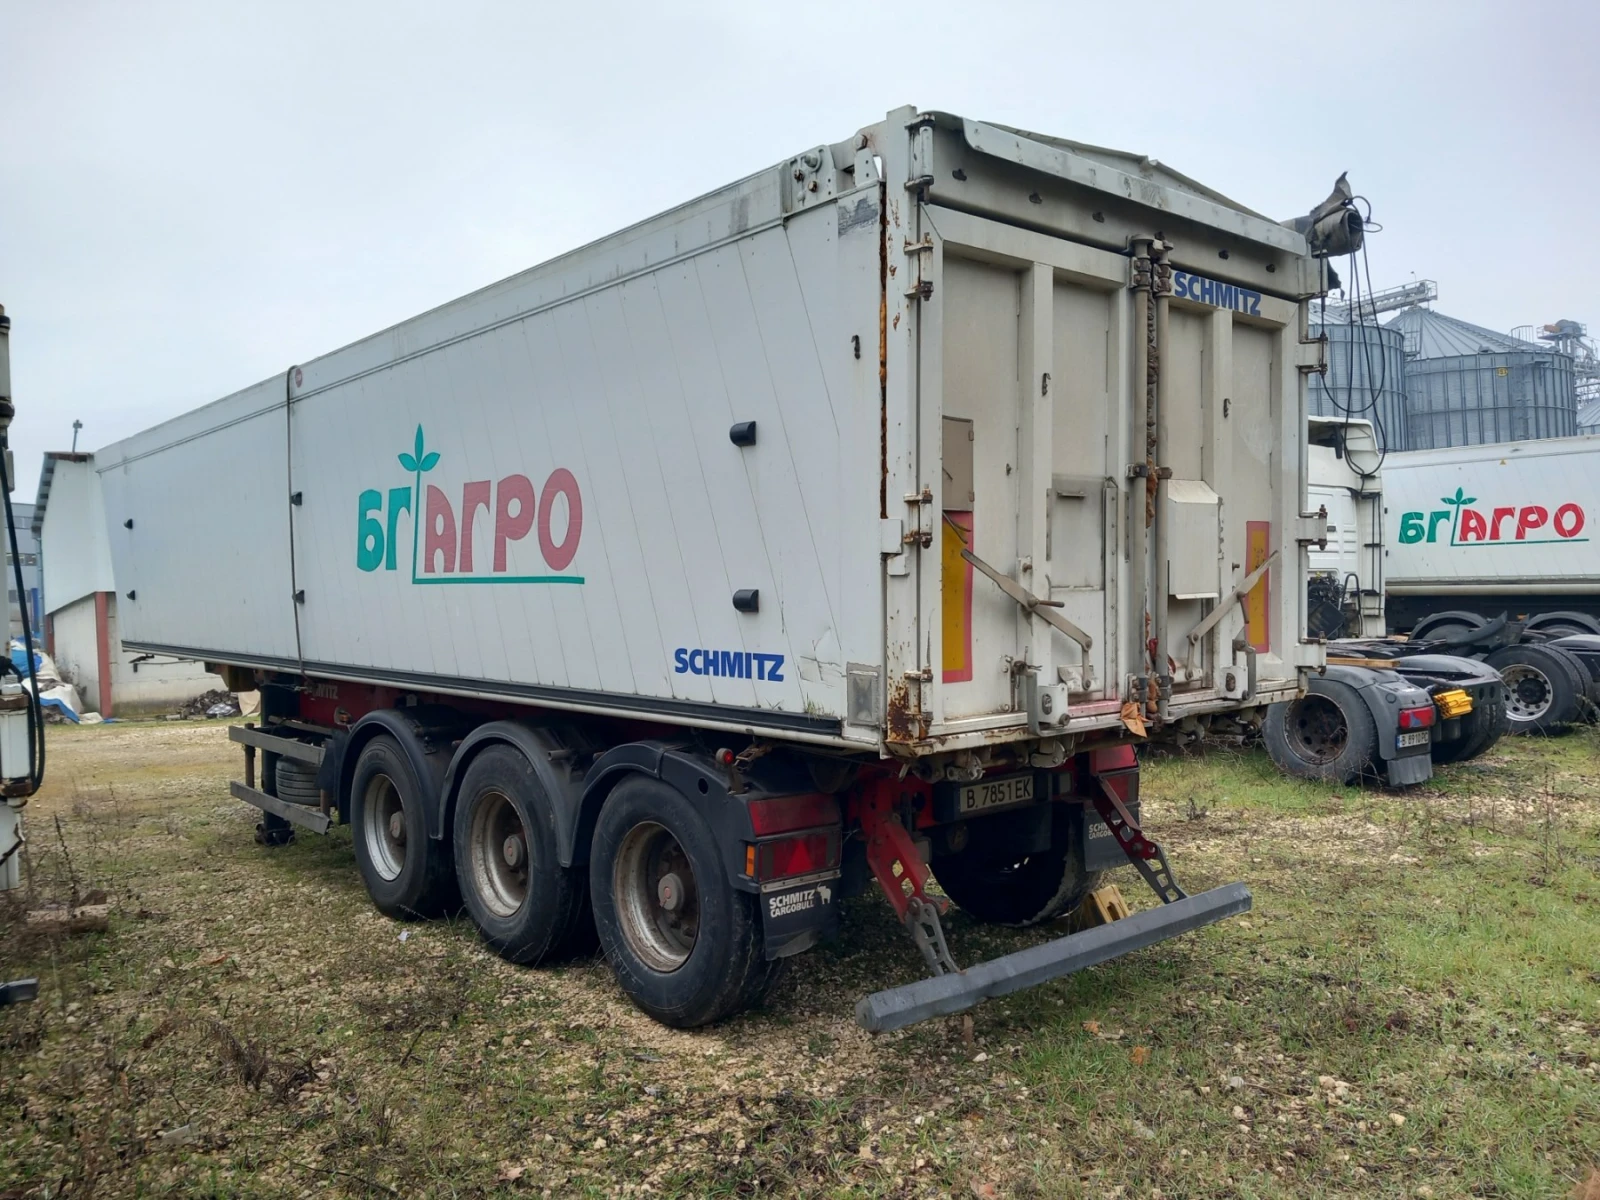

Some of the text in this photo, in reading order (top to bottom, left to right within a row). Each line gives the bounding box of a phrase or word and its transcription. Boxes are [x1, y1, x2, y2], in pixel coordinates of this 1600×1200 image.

[1174, 271, 1261, 317] SCHMITZ
[674, 648, 785, 682] SCHMITZ
[769, 889, 816, 910] SCHMITZ
[770, 900, 815, 918] CARGOBULL
